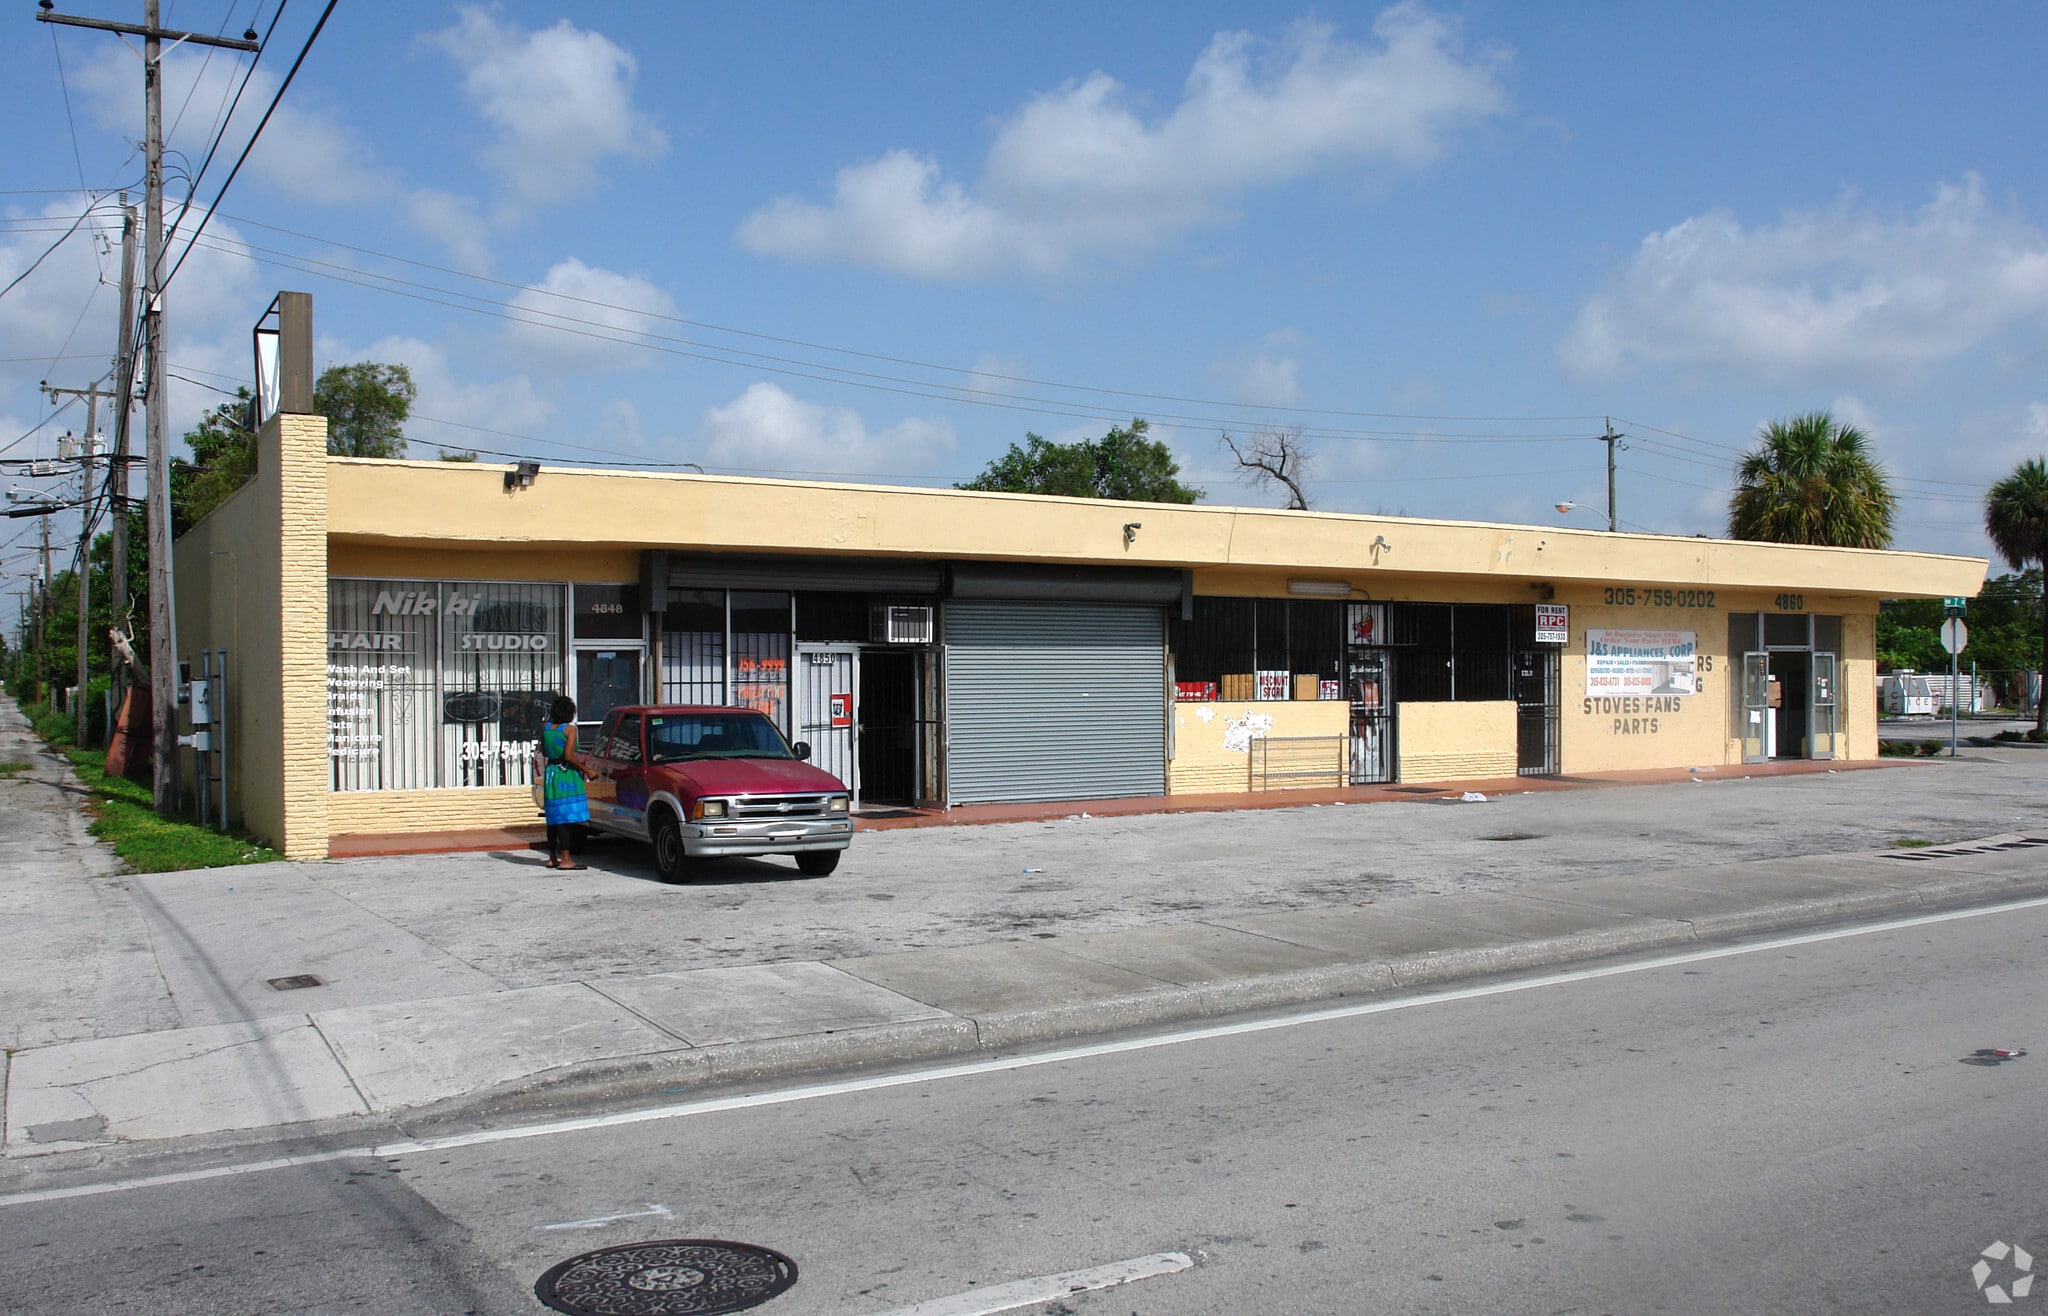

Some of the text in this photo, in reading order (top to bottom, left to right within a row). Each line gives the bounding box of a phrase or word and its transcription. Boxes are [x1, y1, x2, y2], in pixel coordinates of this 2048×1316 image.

[1604, 587, 1716, 608] 305-759-0202
[1775, 593, 1804, 611] 4860
[591, 603, 623, 614] 4848
[1537, 605, 1566, 615] FOR RENT
[1539, 615, 1565, 627] RPC
[328, 633, 548, 650] HAIR STUDIO
[1590, 640, 1693, 659] J&S APPLIANCES, CORP
[812, 653, 837, 664] 4850
[361, 664, 386, 674] And
[389, 665, 411, 674] Set
[1263, 687, 1284, 698] STORE
[328, 706, 375, 716] nfusion
[1583, 696, 1681, 715] STOVES FANS
[1613, 717, 1659, 735] PARTS
[462, 740, 541, 760] 305-754-05
